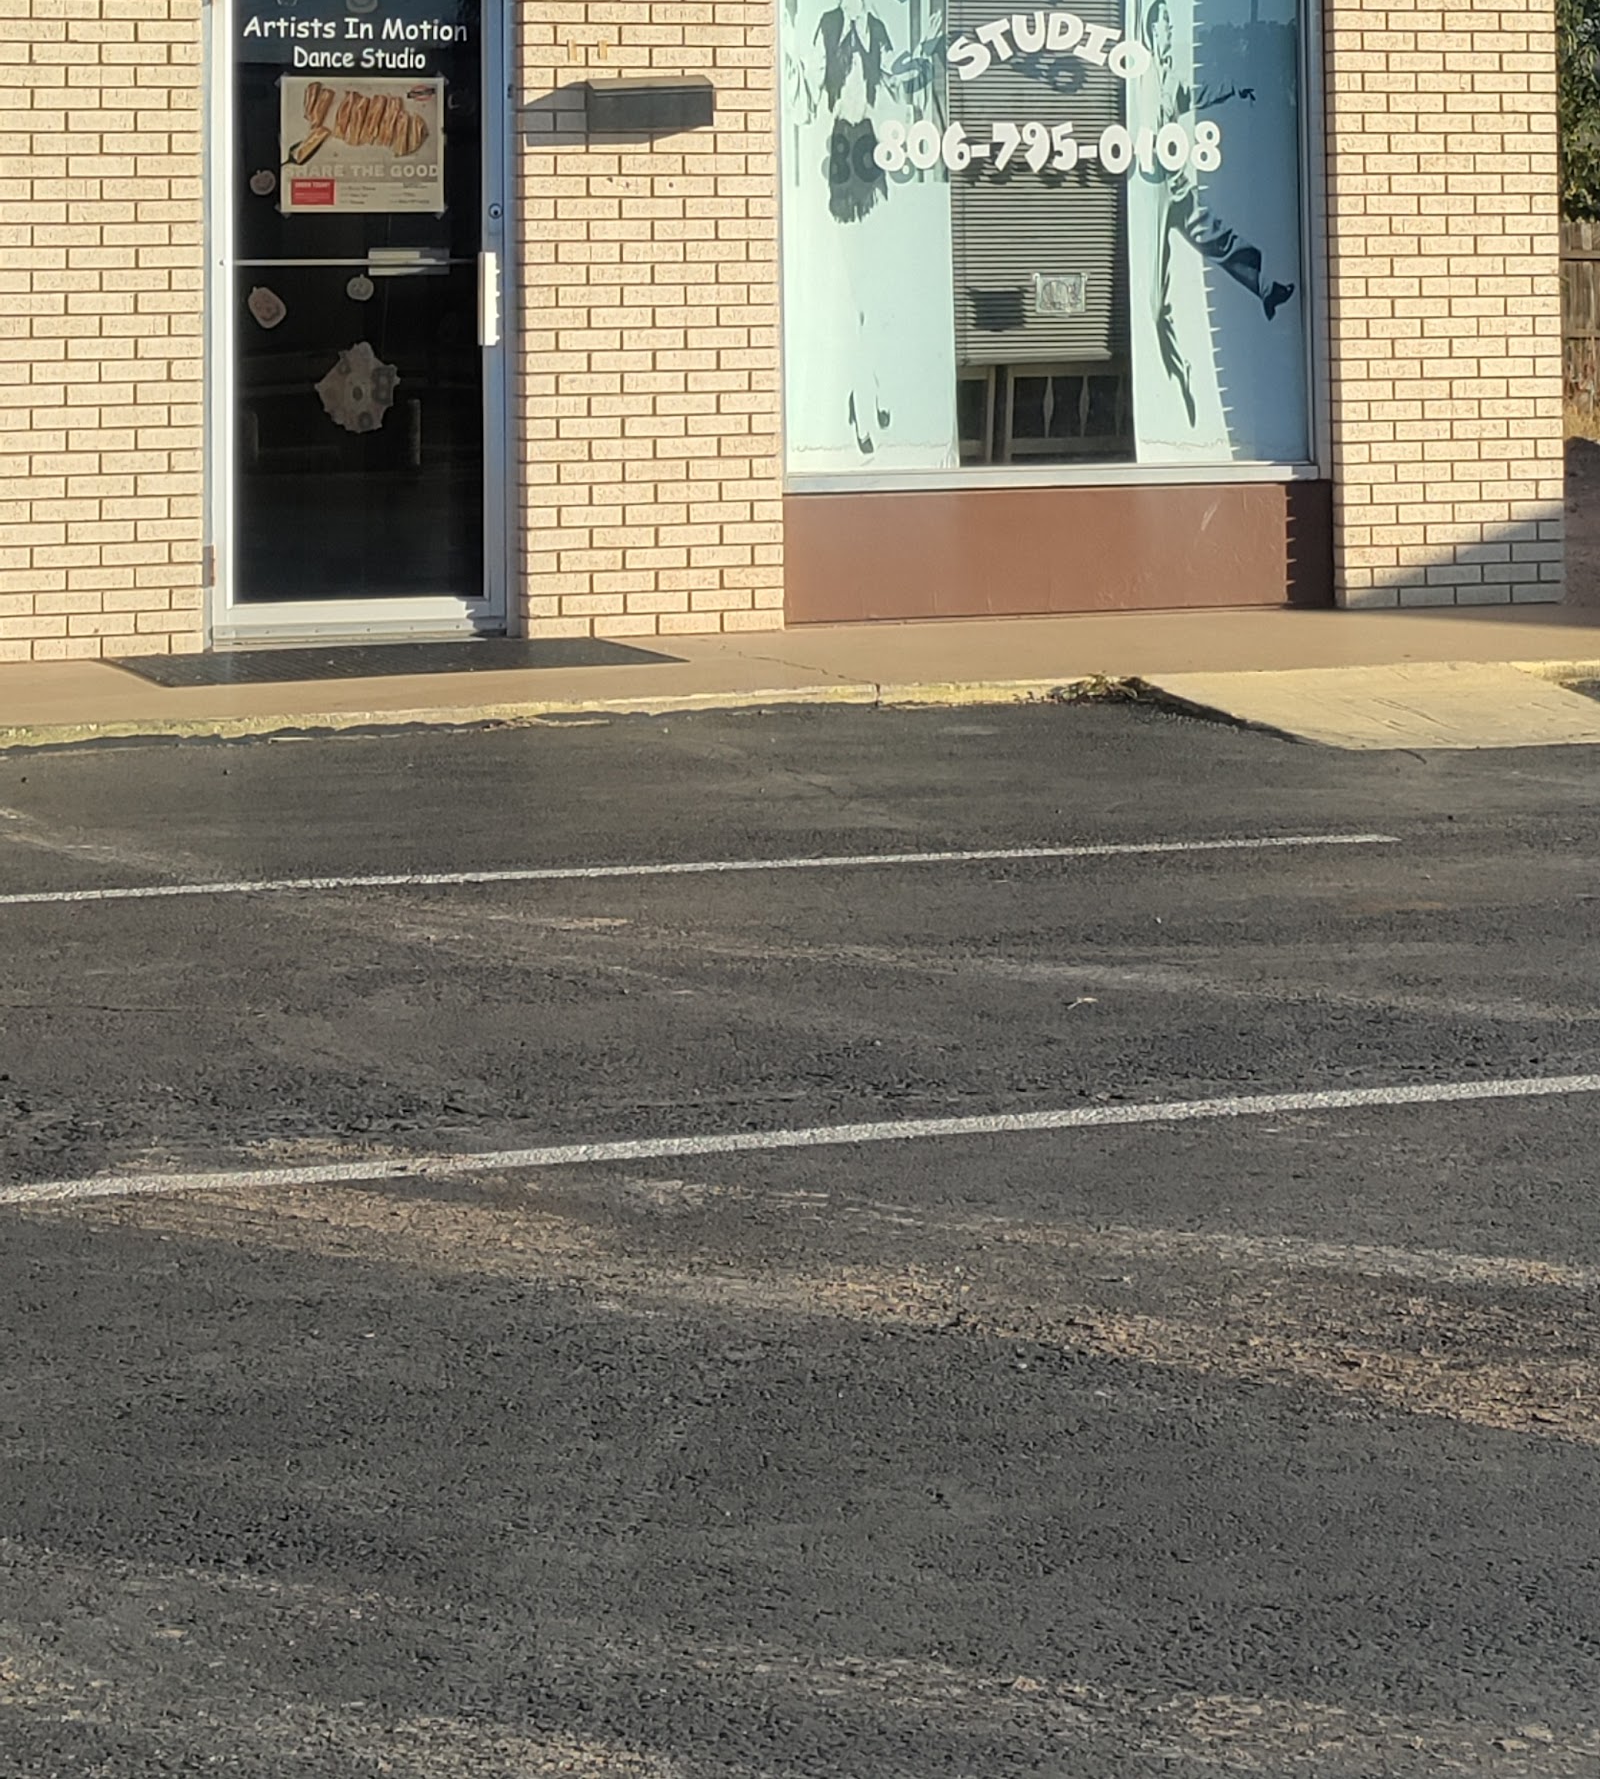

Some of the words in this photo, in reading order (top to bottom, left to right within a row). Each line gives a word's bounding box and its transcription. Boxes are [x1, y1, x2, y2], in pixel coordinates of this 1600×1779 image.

[243, 16, 336, 39] Artists
[344, 18, 373, 40] In
[382, 18, 467, 42] Motion
[293, 45, 355, 68] Dance
[360, 47, 426, 69] Studio
[946, 11, 1151, 81] STUDIO
[873, 121, 1221, 174] 806-795-0108
[351, 165, 384, 178] THE
[391, 165, 438, 178] GOOD
